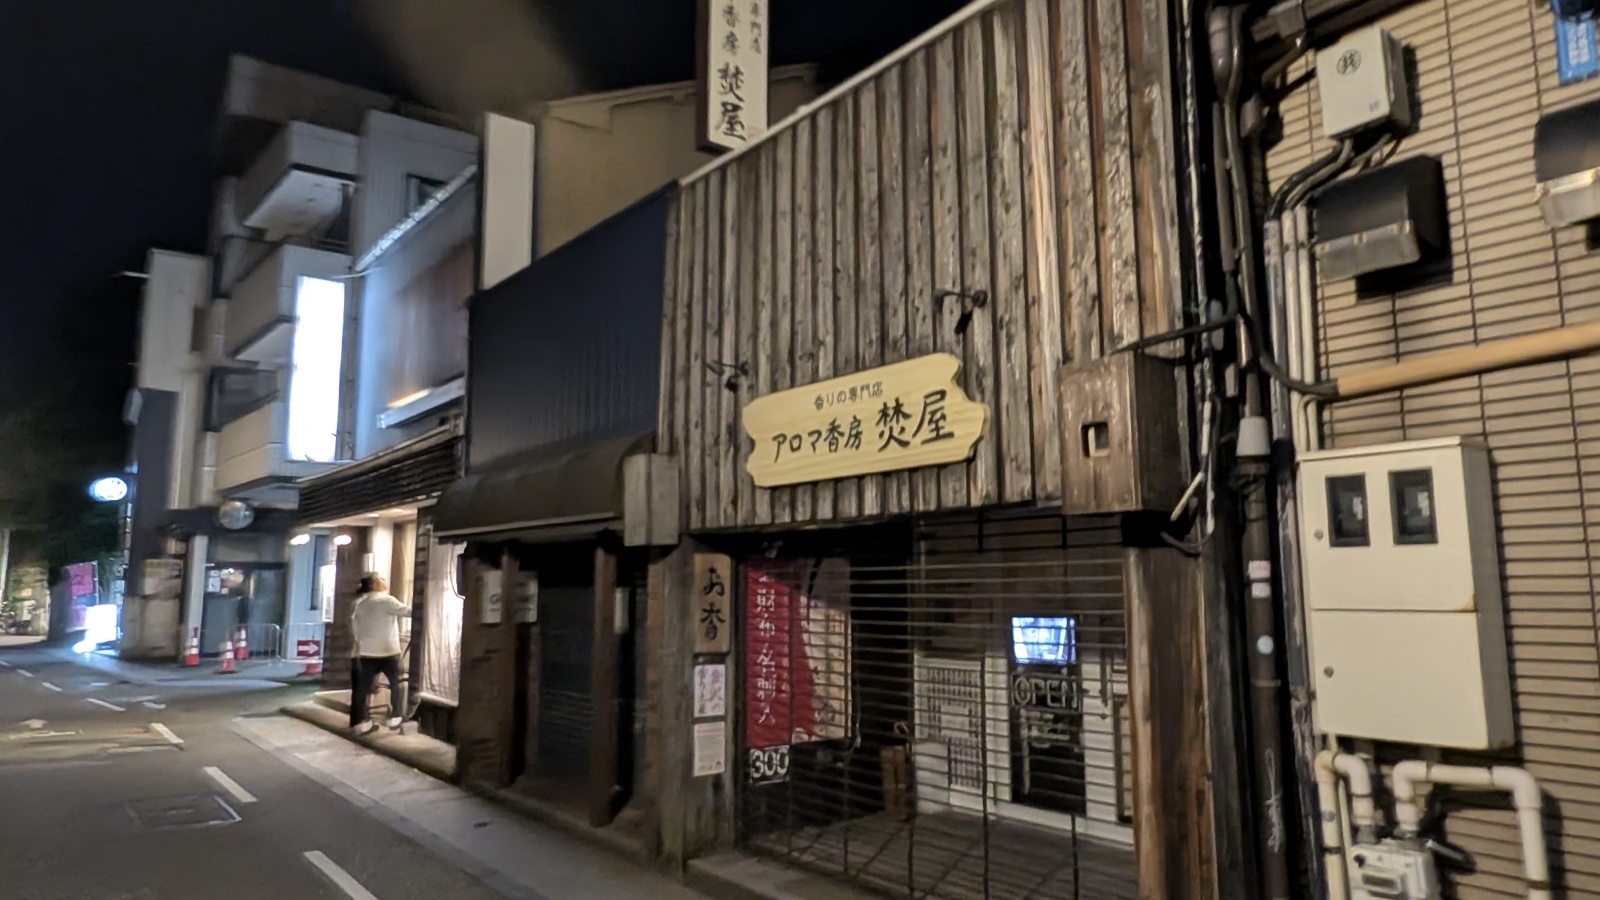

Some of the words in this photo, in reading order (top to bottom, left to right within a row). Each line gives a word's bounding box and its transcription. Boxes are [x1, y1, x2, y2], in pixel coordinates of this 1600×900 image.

[715, 62, 747, 142] 焚屋
[814, 381, 883, 410] 香りの専門店
[771, 415, 864, 463] アロマ香房
[875, 388, 954, 453] 焚屋
[700, 566, 726, 641] お香
[1014, 677, 1078, 708] OPEN
[751, 748, 789, 778] 300
